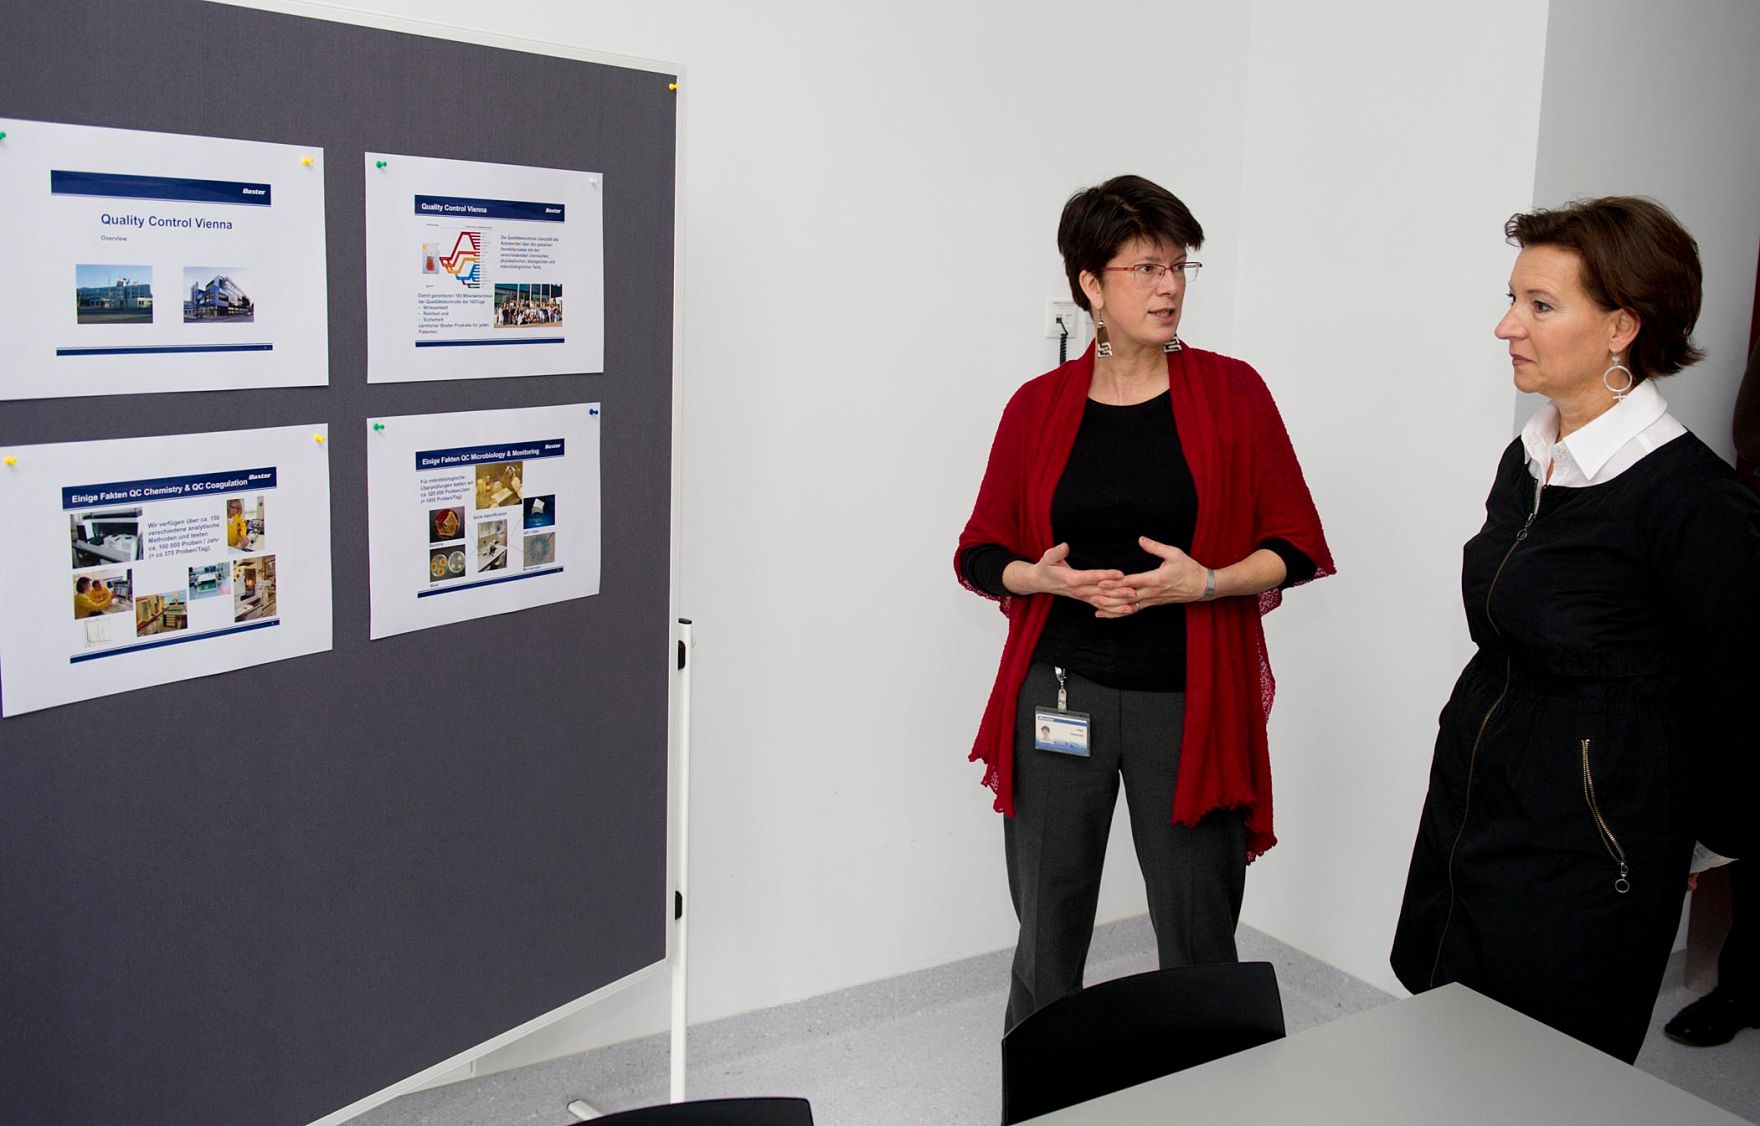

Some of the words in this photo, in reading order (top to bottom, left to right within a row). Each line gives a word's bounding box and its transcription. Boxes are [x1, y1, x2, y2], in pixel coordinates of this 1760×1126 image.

[242, 188, 267, 196] Baxter
[422, 203, 443, 212] Quality
[444, 204, 466, 212] Control
[101, 213, 145, 229] Quality
[148, 216, 192, 228] Control
[195, 218, 233, 230] Vienna
[422, 457, 440, 466] Einige
[441, 455, 460, 464] Fakten
[471, 451, 506, 461] Microbiology
[512, 448, 540, 457] Monitoring
[72, 493, 98, 504] Einige
[100, 491, 127, 500] Fakten
[129, 488, 142, 498] QC
[144, 485, 182, 496] Chemistry
[184, 484, 190, 492] &
[192, 482, 204, 491] QC
[206, 479, 248, 490] Coagulation
[159, 519, 185, 527] verfügen
[148, 527, 187, 536] verschiedene
[188, 523, 220, 532] analytische
[148, 536, 177, 544] Methoden
